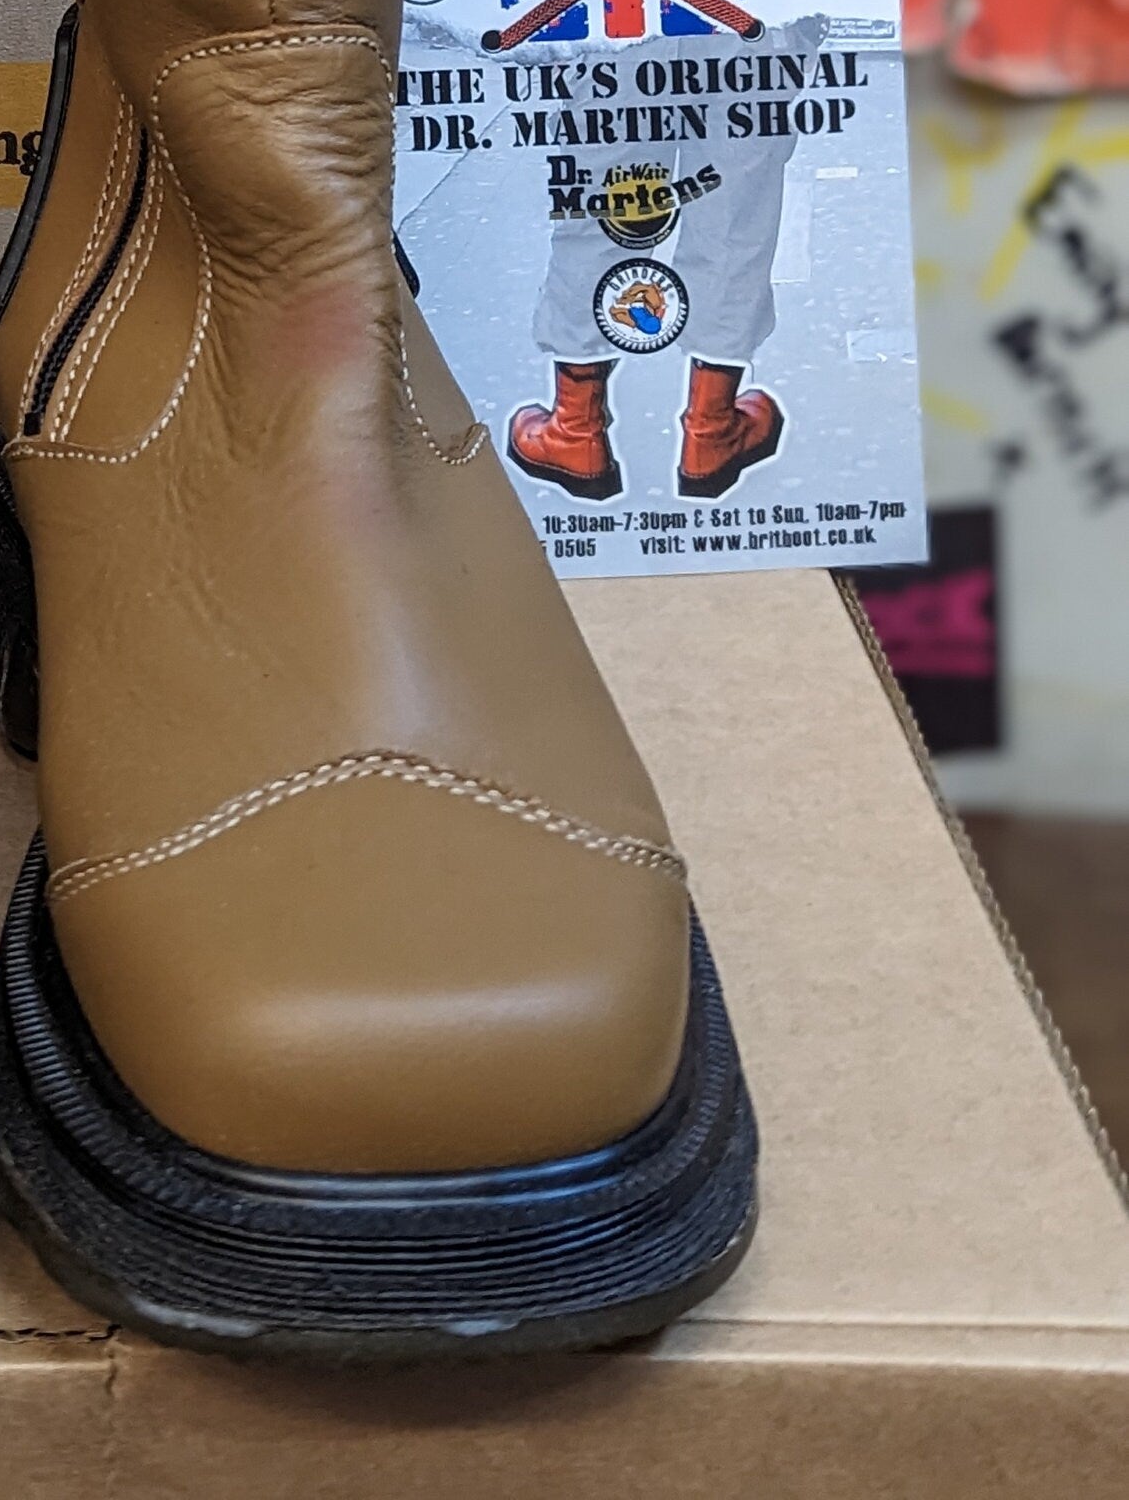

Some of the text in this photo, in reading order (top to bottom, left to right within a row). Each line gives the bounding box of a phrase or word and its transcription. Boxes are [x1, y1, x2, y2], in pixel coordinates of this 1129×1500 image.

[395, 51, 869, 107] THE UK'S ORIGINAL
[410, 98, 856, 152] DR. MARTEN SHOP
[546, 155, 593, 186] Dr.
[548, 163, 723, 220] Martens
[710, 507, 741, 527] Sat
[747, 507, 766, 525] to
